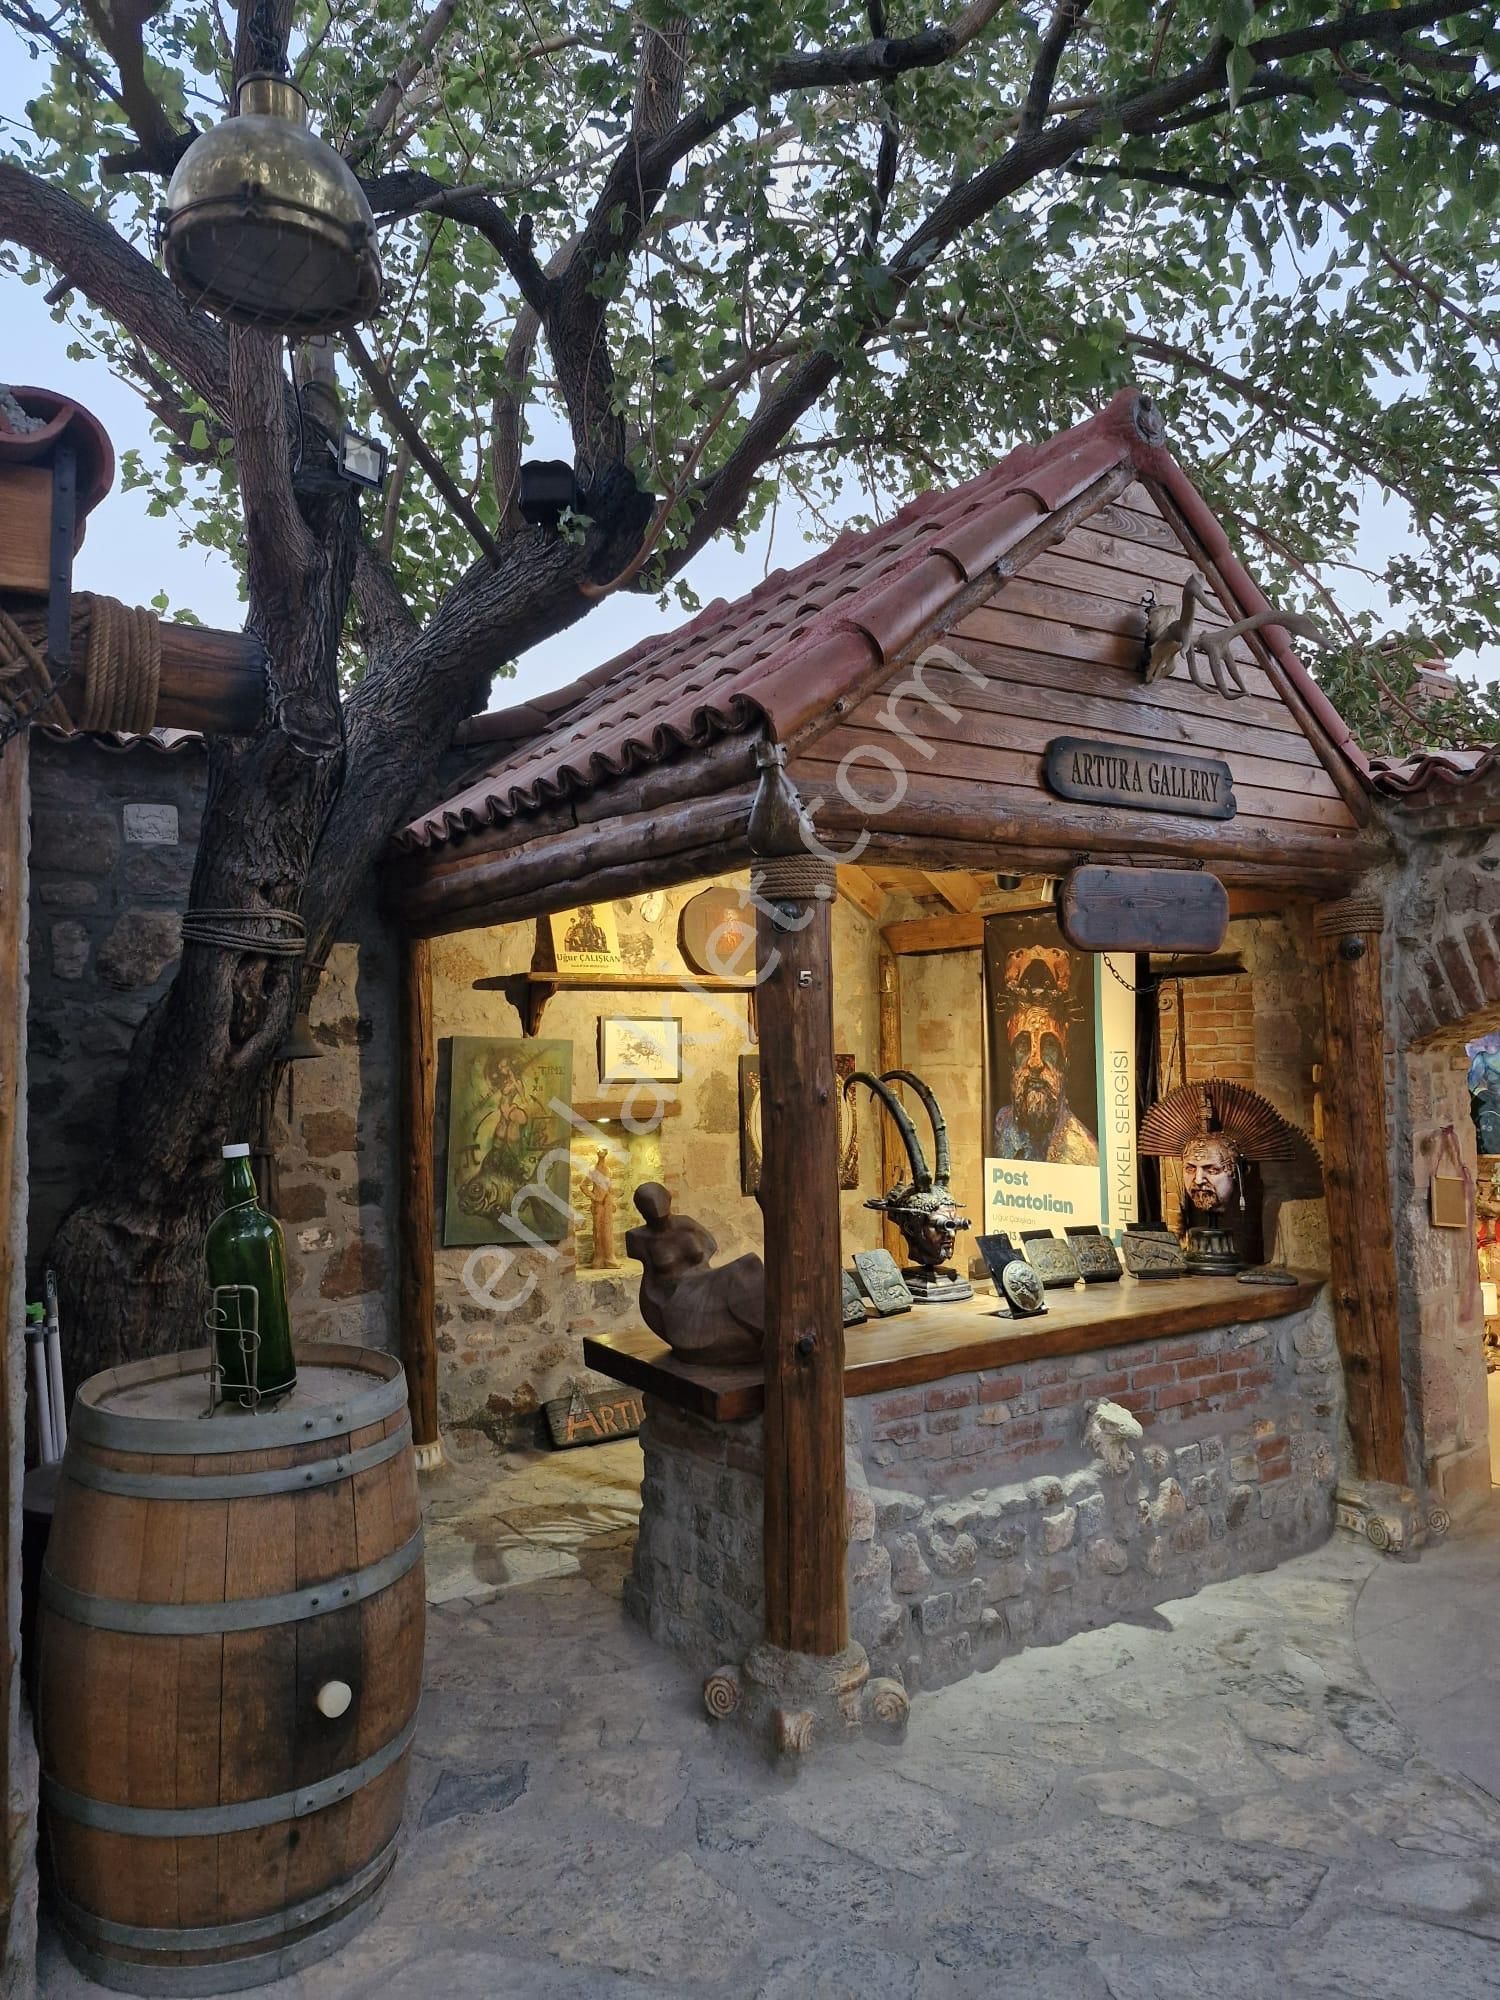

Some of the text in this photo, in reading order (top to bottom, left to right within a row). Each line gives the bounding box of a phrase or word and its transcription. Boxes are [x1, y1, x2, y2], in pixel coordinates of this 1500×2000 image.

[1071, 751, 1220, 803] ARTURA GALLERY
[799, 970, 813, 988] 5
[1109, 1050, 1133, 1223] HEYKEL SERGİSİ
[992, 1167, 1029, 1186] Post
[992, 1189, 1074, 1215] Anatolian
